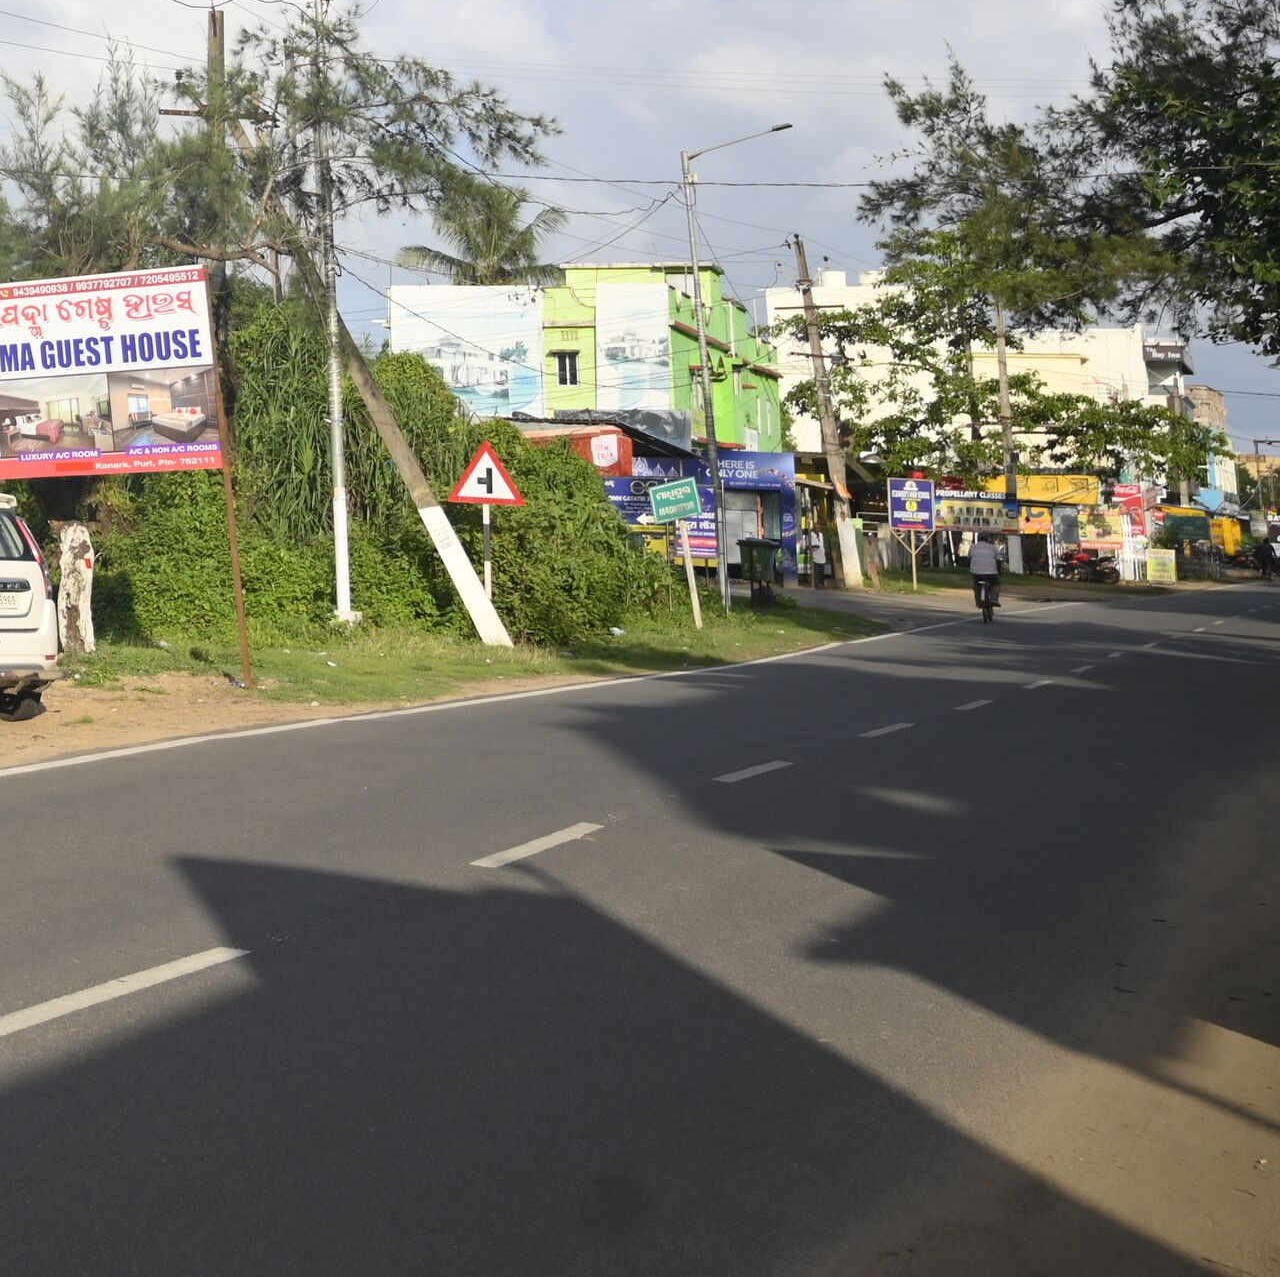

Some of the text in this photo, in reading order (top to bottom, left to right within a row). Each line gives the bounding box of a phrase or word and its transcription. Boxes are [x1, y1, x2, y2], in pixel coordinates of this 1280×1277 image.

[13, 284, 68, 297] 9439490938
[75, 278, 132, 290] 9937792707
[140, 271, 199, 284] 7205495512
[40, 336, 114, 369] GUEST
[120, 329, 202, 363] HOUSE
[20, 450, 98, 461] LUXURY A/C ROOM
[128, 448, 143, 456] A/C
[171, 445, 185, 453] A/C
[187, 444, 217, 452] ROOMS
[179, 457, 215, 465] 752111
[717, 459, 755, 469] HERE IS
[735, 470, 759, 479] ONE
[935, 489, 1006, 500] PROPELLANT CLASSES
[659, 501, 695, 515] MADHIPUR
